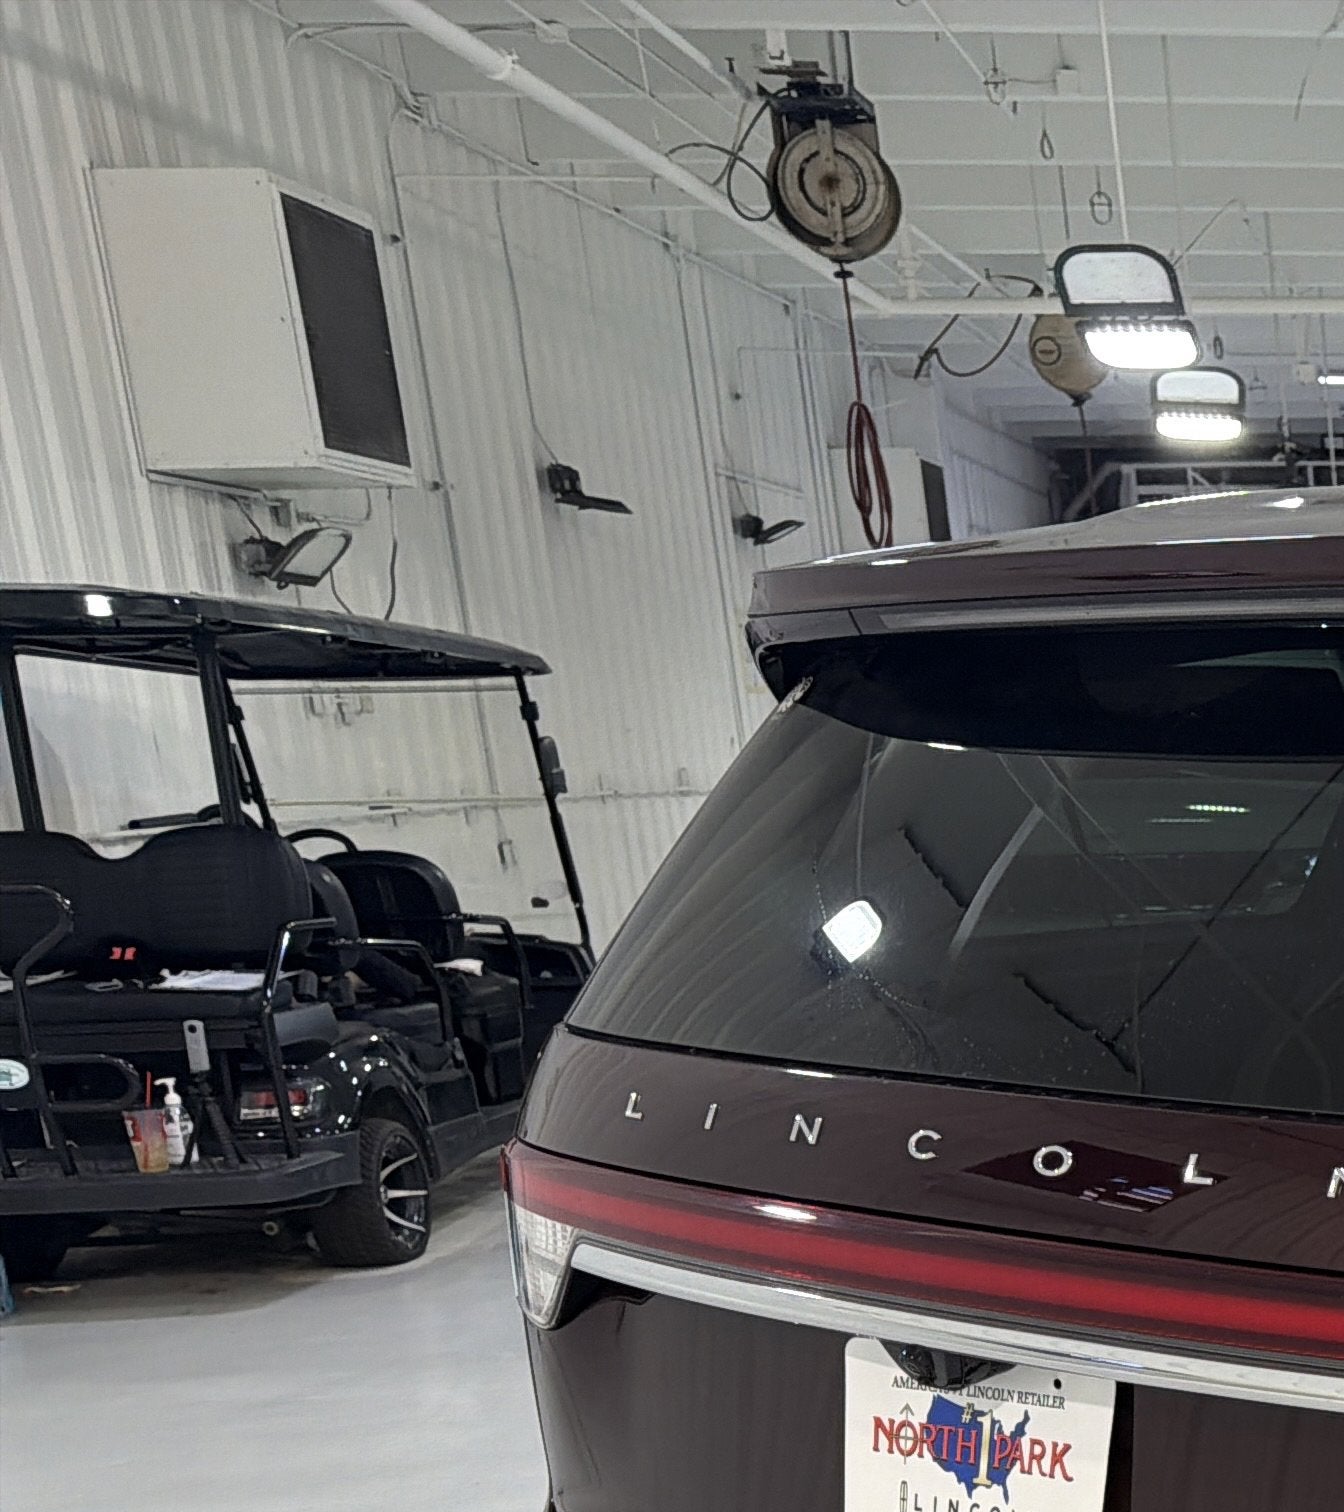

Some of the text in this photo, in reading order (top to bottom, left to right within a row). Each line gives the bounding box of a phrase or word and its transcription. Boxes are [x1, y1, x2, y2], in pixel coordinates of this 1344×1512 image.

[966, 1384, 1016, 1403] LINCOLN
[1017, 1390, 1066, 1410] RETAILER
[872, 1415, 1075, 1482] NORTH PARK
